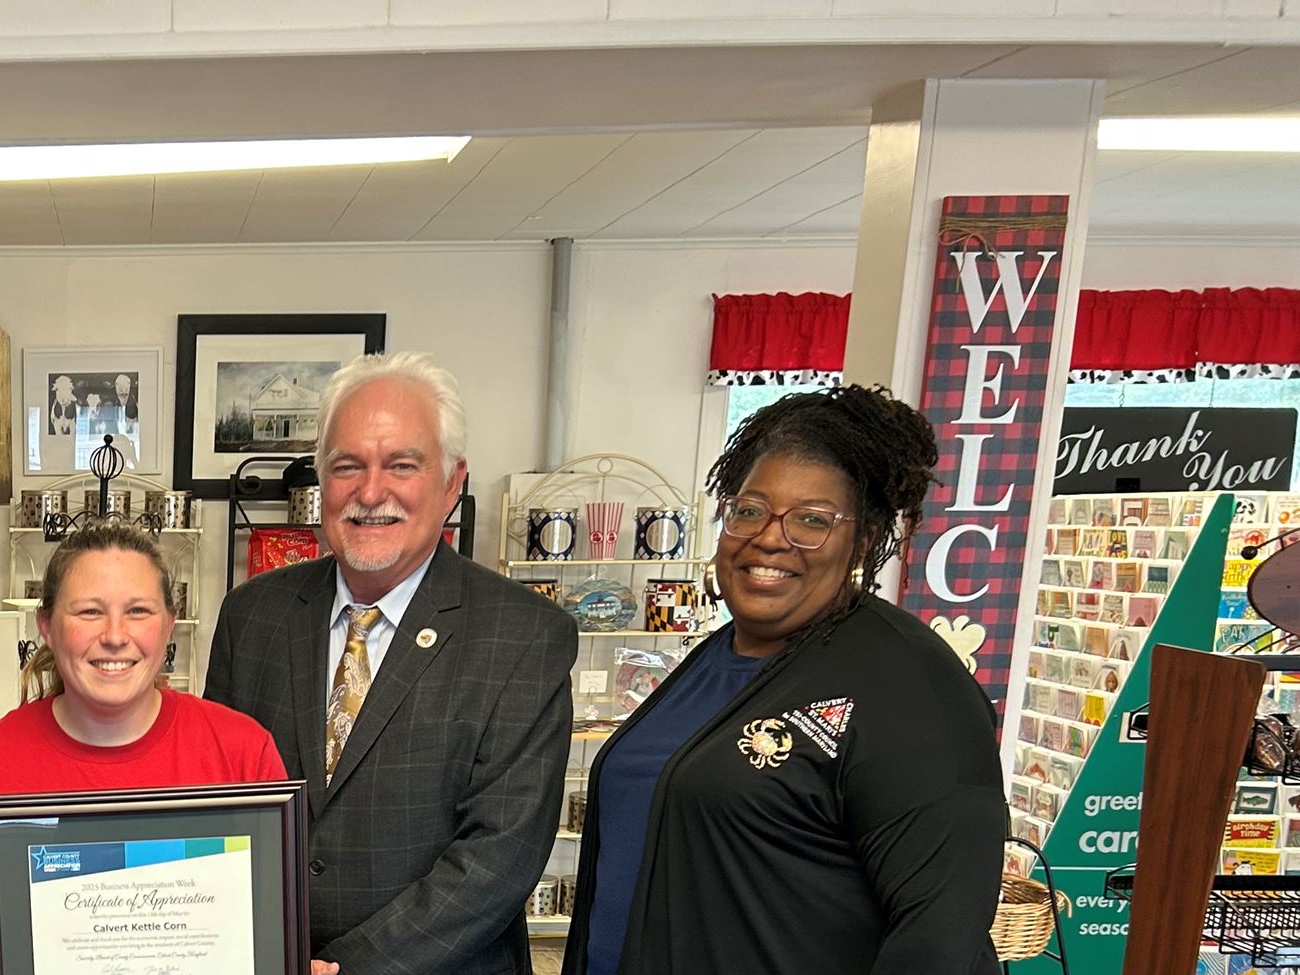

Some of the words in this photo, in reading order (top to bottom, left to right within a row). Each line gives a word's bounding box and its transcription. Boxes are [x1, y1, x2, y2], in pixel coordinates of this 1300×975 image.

[1055, 410, 1212, 480] Thank
[1183, 450, 1287, 491] You
[810, 698, 848, 709] CALVERT
[1078, 830, 1140, 853] car
[101, 882, 129, 890] Business
[131, 880, 174, 891] Appreciation
[175, 879, 196, 888] Week
[64, 892, 124, 914] Certificate
[126, 893, 139, 912] of
[137, 889, 216, 910] Appreciation
[93, 924, 128, 933] Calvert
[131, 922, 161, 931] Kettle
[163, 921, 187, 930] Corn
